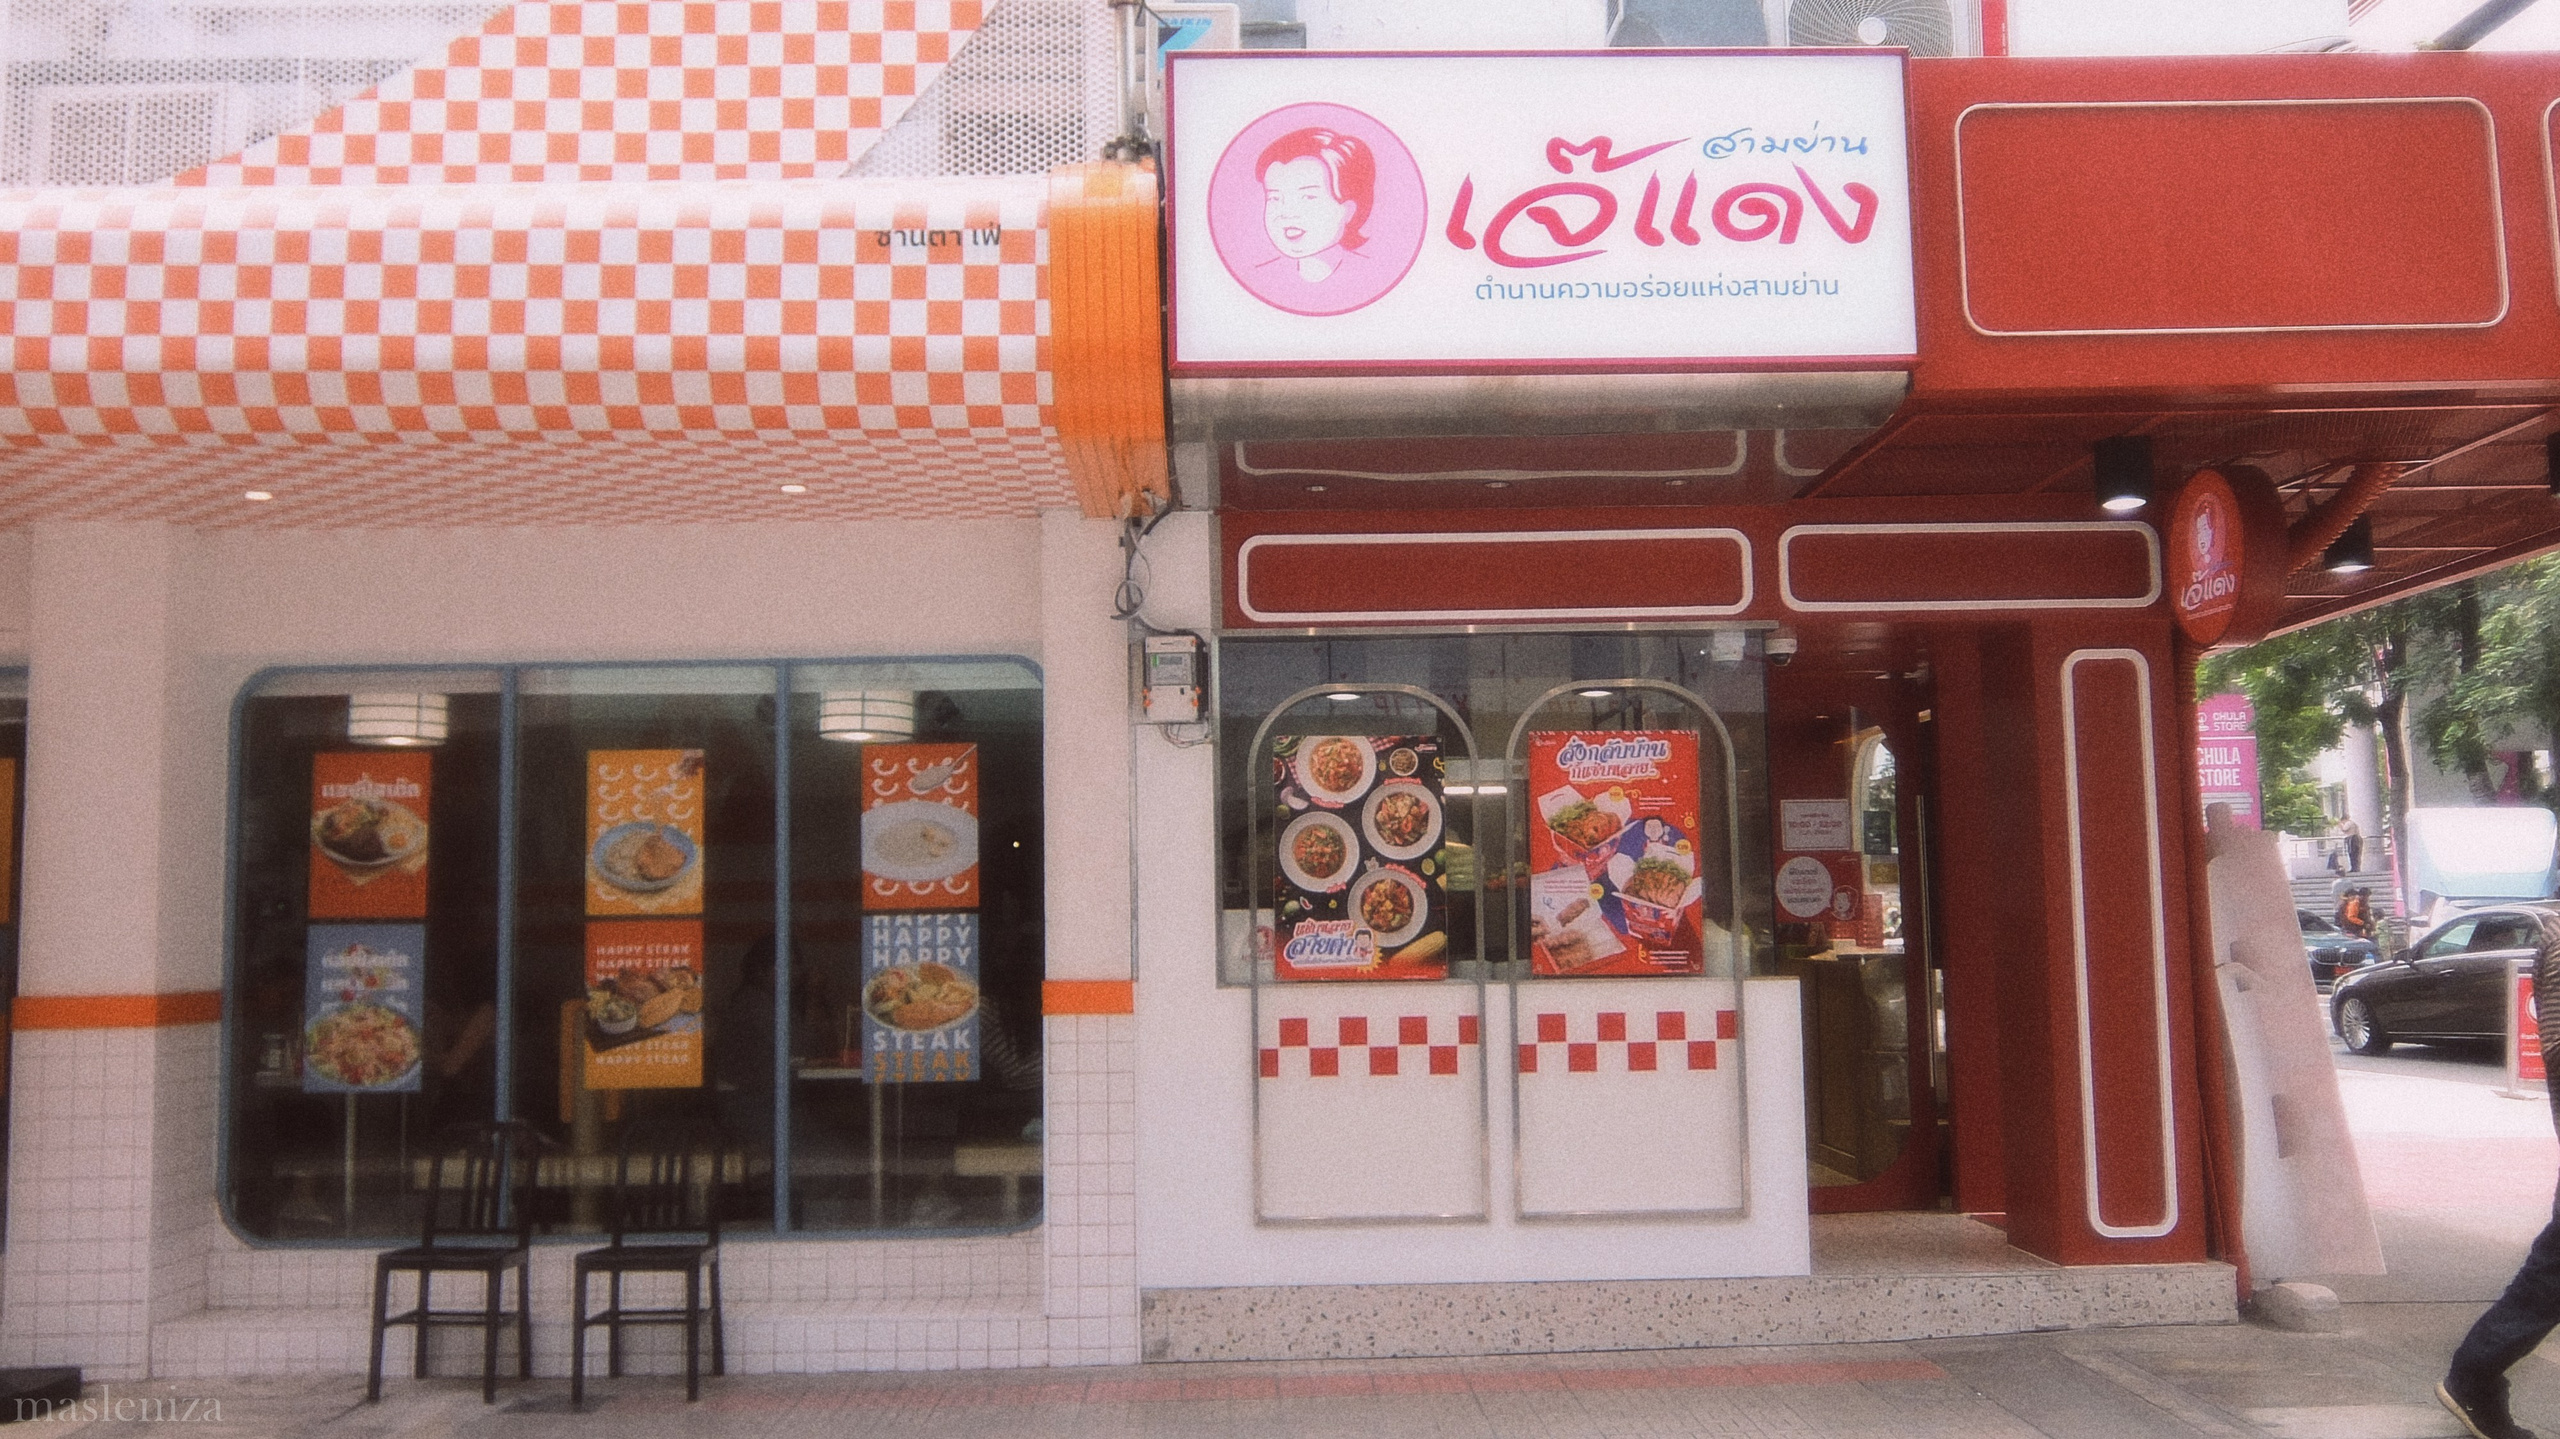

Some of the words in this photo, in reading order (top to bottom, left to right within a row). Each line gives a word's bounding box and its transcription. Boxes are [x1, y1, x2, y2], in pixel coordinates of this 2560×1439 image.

[1702, 120, 1869, 160] สามย่าน
[1445, 135, 1880, 268] เจ๊แดง
[1474, 271, 1840, 301] ตำนานความอร่อยแห่งสามย่าน
[2212, 711, 2247, 721] CHULA
[2213, 721, 2247, 731] STORE
[2198, 768, 2242, 787] STORE
[873, 926, 971, 947] HAPPY
[597, 945, 641, 955] HAPPY
[873, 946, 972, 969] HAPPY
[873, 1029, 971, 1051] STEAK
[874, 1050, 971, 1072] STEAK
